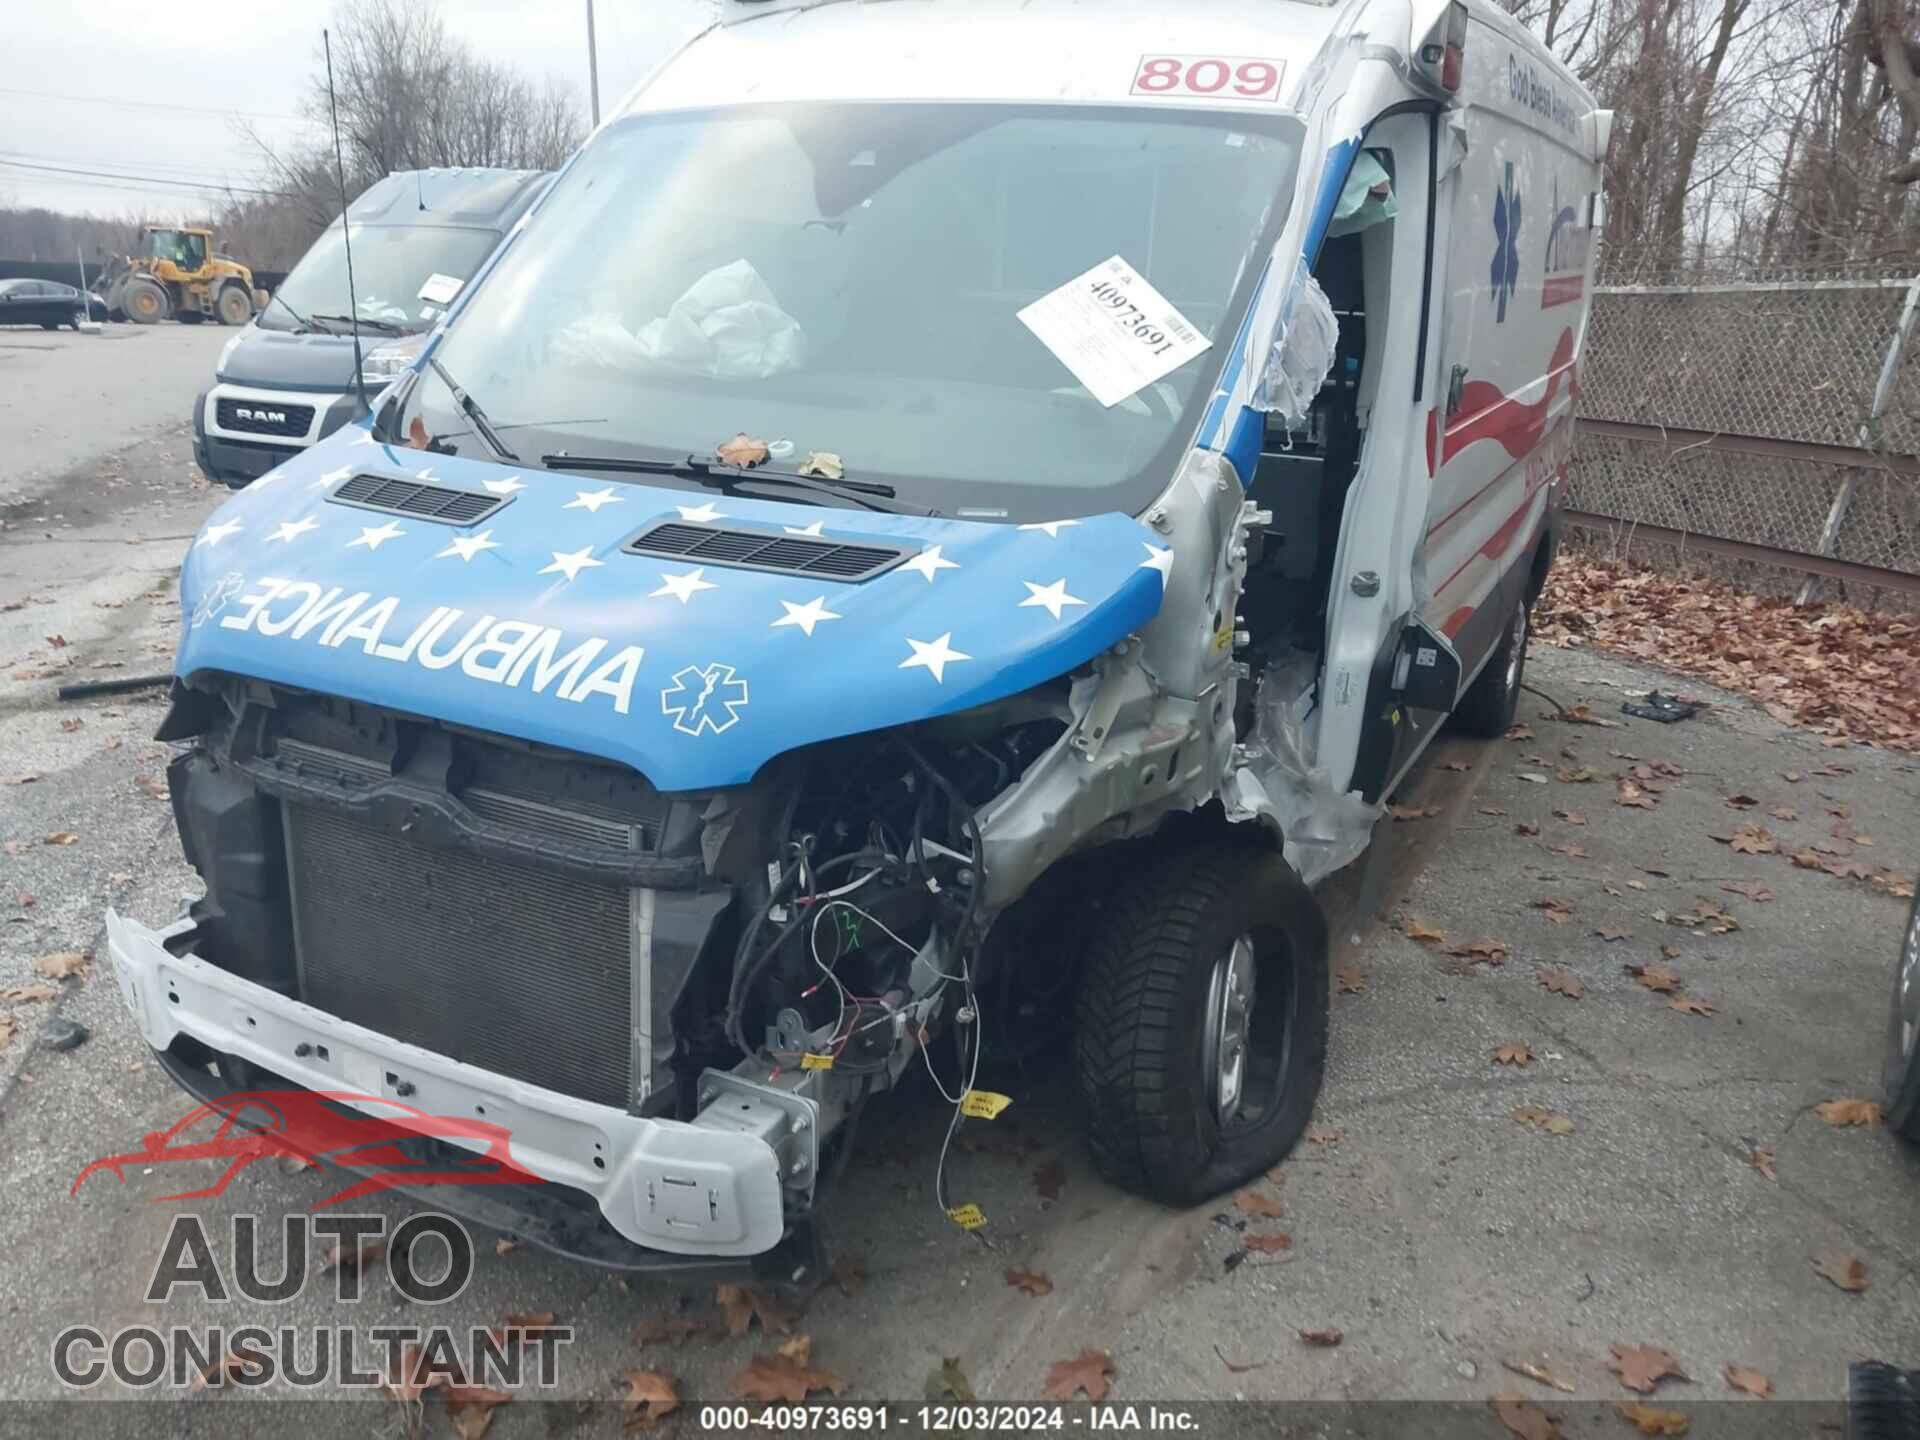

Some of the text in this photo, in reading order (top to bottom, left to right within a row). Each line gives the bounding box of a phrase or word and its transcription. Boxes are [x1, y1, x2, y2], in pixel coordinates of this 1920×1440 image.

[1136, 58, 1278, 96] 809
[1089, 281, 1174, 355] 40973691
[236, 408, 286, 423] RAM
